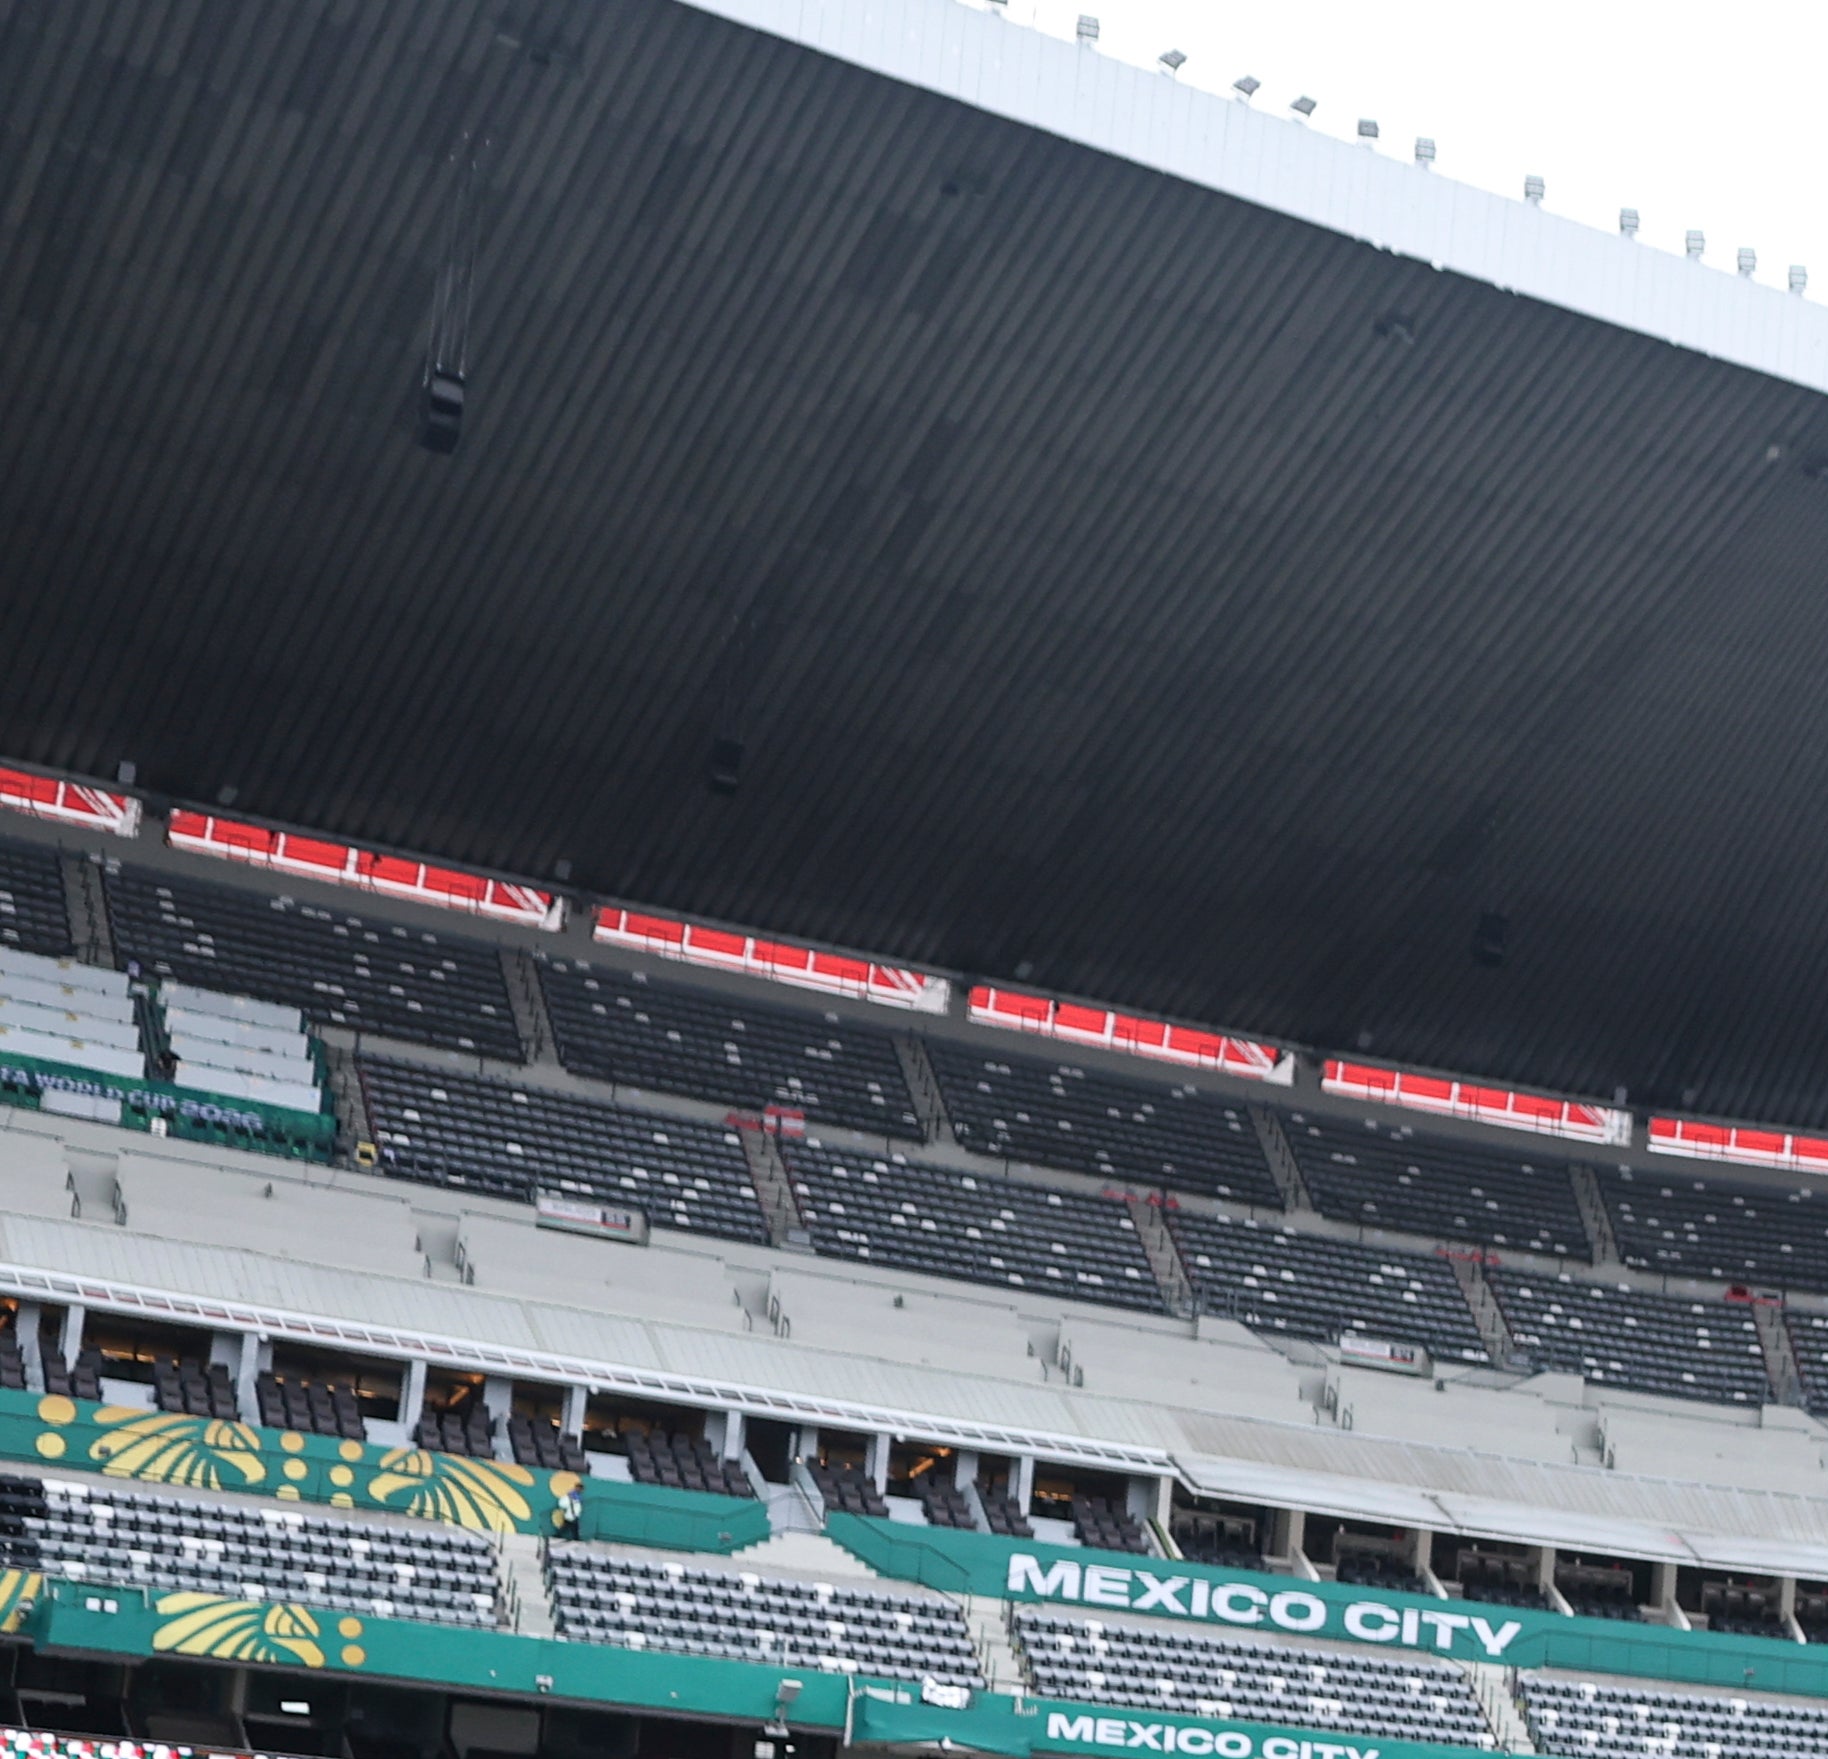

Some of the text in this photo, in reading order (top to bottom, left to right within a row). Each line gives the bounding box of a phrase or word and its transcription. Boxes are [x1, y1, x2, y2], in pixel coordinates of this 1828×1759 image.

[1008, 1553, 1522, 1656] MEXICO CITY
[1046, 1712, 1253, 1758] MEXICO
